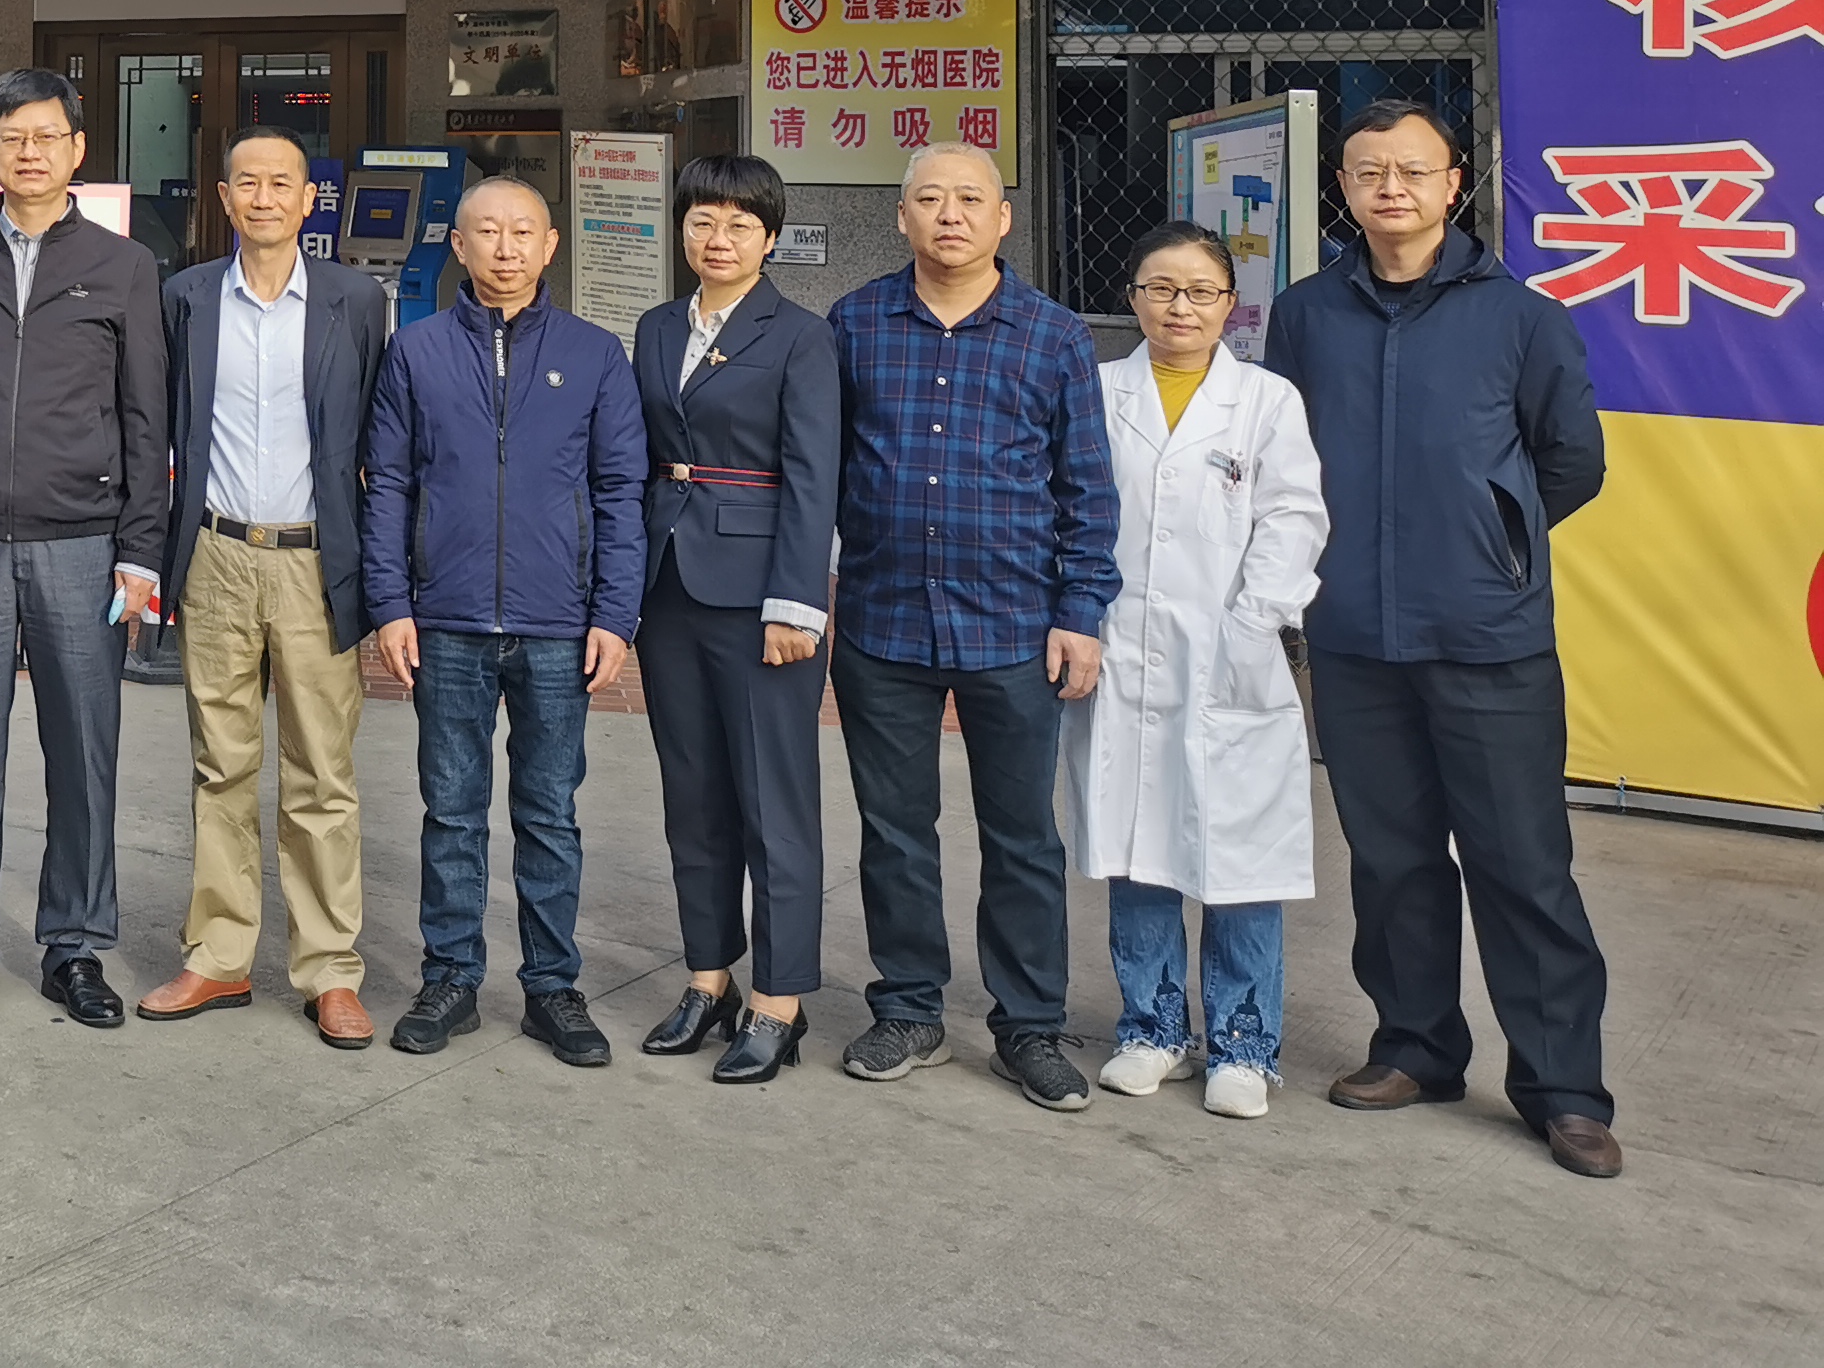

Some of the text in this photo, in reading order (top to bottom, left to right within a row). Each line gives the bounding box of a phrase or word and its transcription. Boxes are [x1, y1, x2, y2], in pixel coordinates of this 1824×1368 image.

[765, 47, 1002, 91] 您已进入无烟医院
[770, 107, 999, 150] 请勿吸烟
[792, 228, 825, 240] WLAN
[494, 338, 506, 378] EXPLORER
